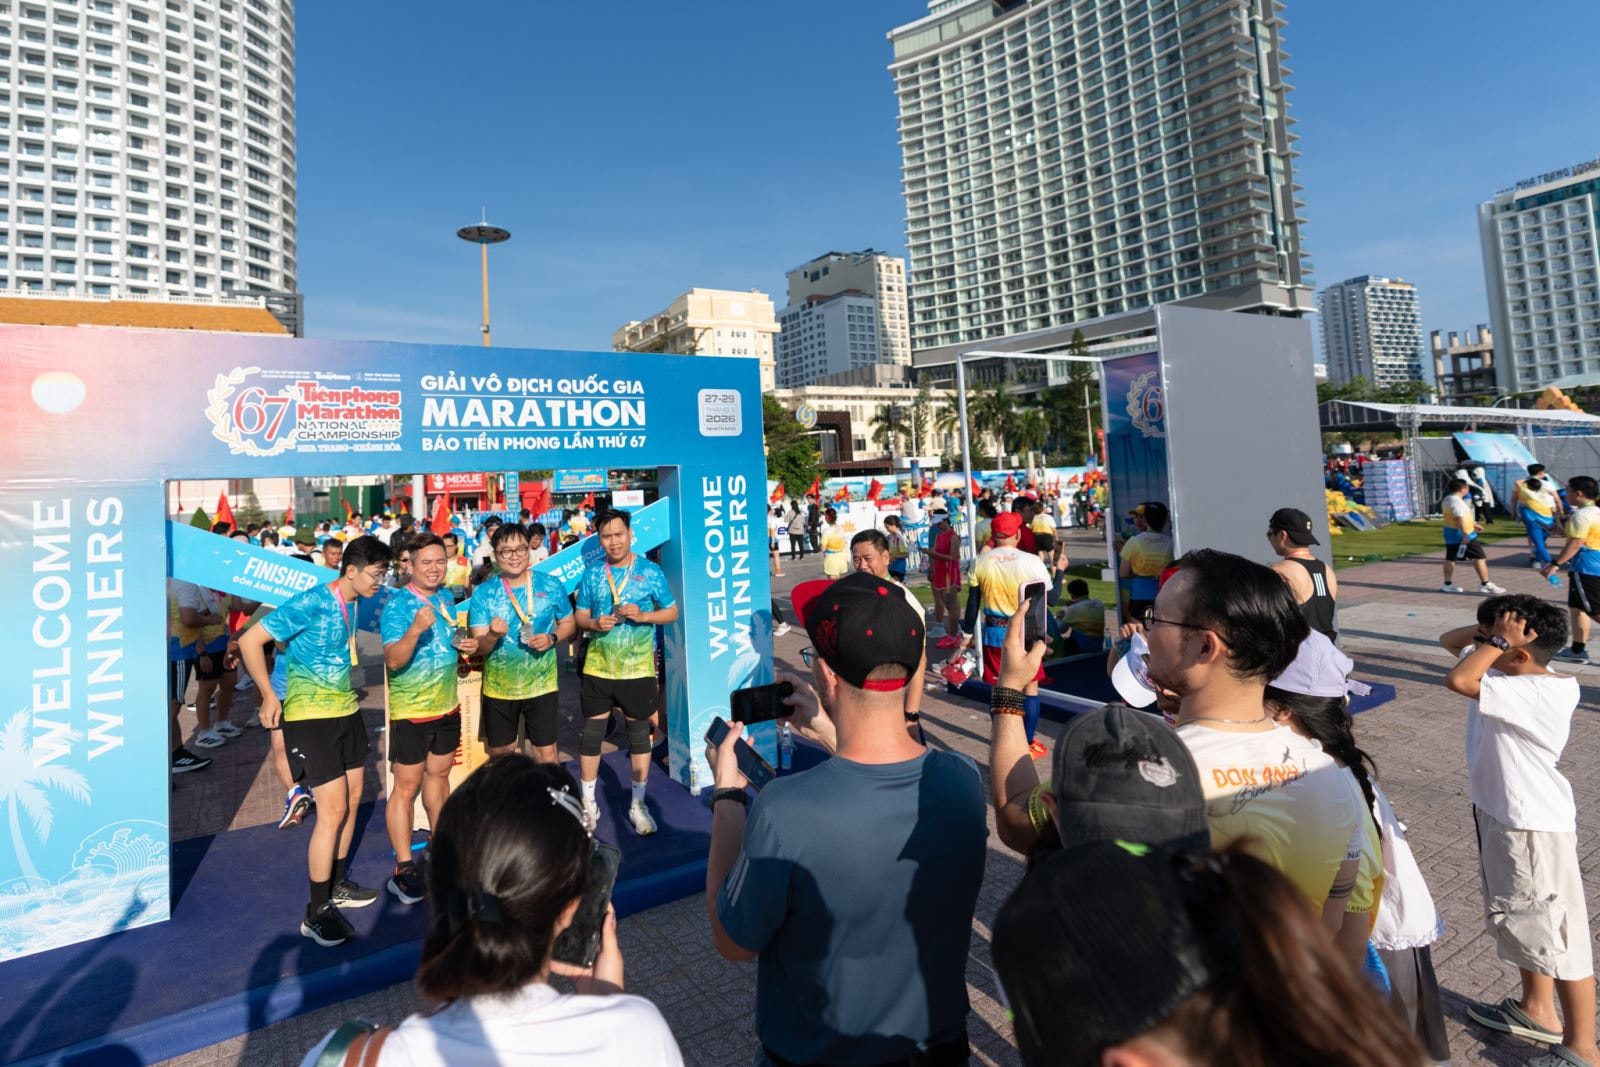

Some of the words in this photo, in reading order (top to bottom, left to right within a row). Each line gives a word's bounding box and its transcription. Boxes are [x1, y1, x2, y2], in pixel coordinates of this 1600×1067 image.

[420, 370, 467, 391] GIẢI
[470, 373, 503, 393] VÔ
[506, 377, 553, 396] ĐỊCH
[556, 373, 609, 395] QUỐC
[612, 379, 645, 394] GIA
[705, 394, 734, 403] 27-29
[233, 387, 291, 440] 67
[297, 404, 400, 420] Marathon
[421, 398, 646, 427] MARATHON
[705, 415, 736, 423] 2026
[298, 421, 366, 430] NATIONAL
[298, 431, 400, 440] CHAMPIONSHIP
[421, 433, 460, 451] BÁO
[463, 431, 500, 451] TIỀN
[503, 436, 561, 450] PHONG
[563, 430, 595, 449] LẦN
[597, 432, 628, 449] THỨ
[629, 435, 647, 448] 67
[446, 474, 482, 484] MIXUE
[702, 475, 729, 661] WELCOME
[728, 474, 753, 656] WINNERS
[32, 498, 72, 768] WELCOME
[86, 496, 124, 762] WINNERS
